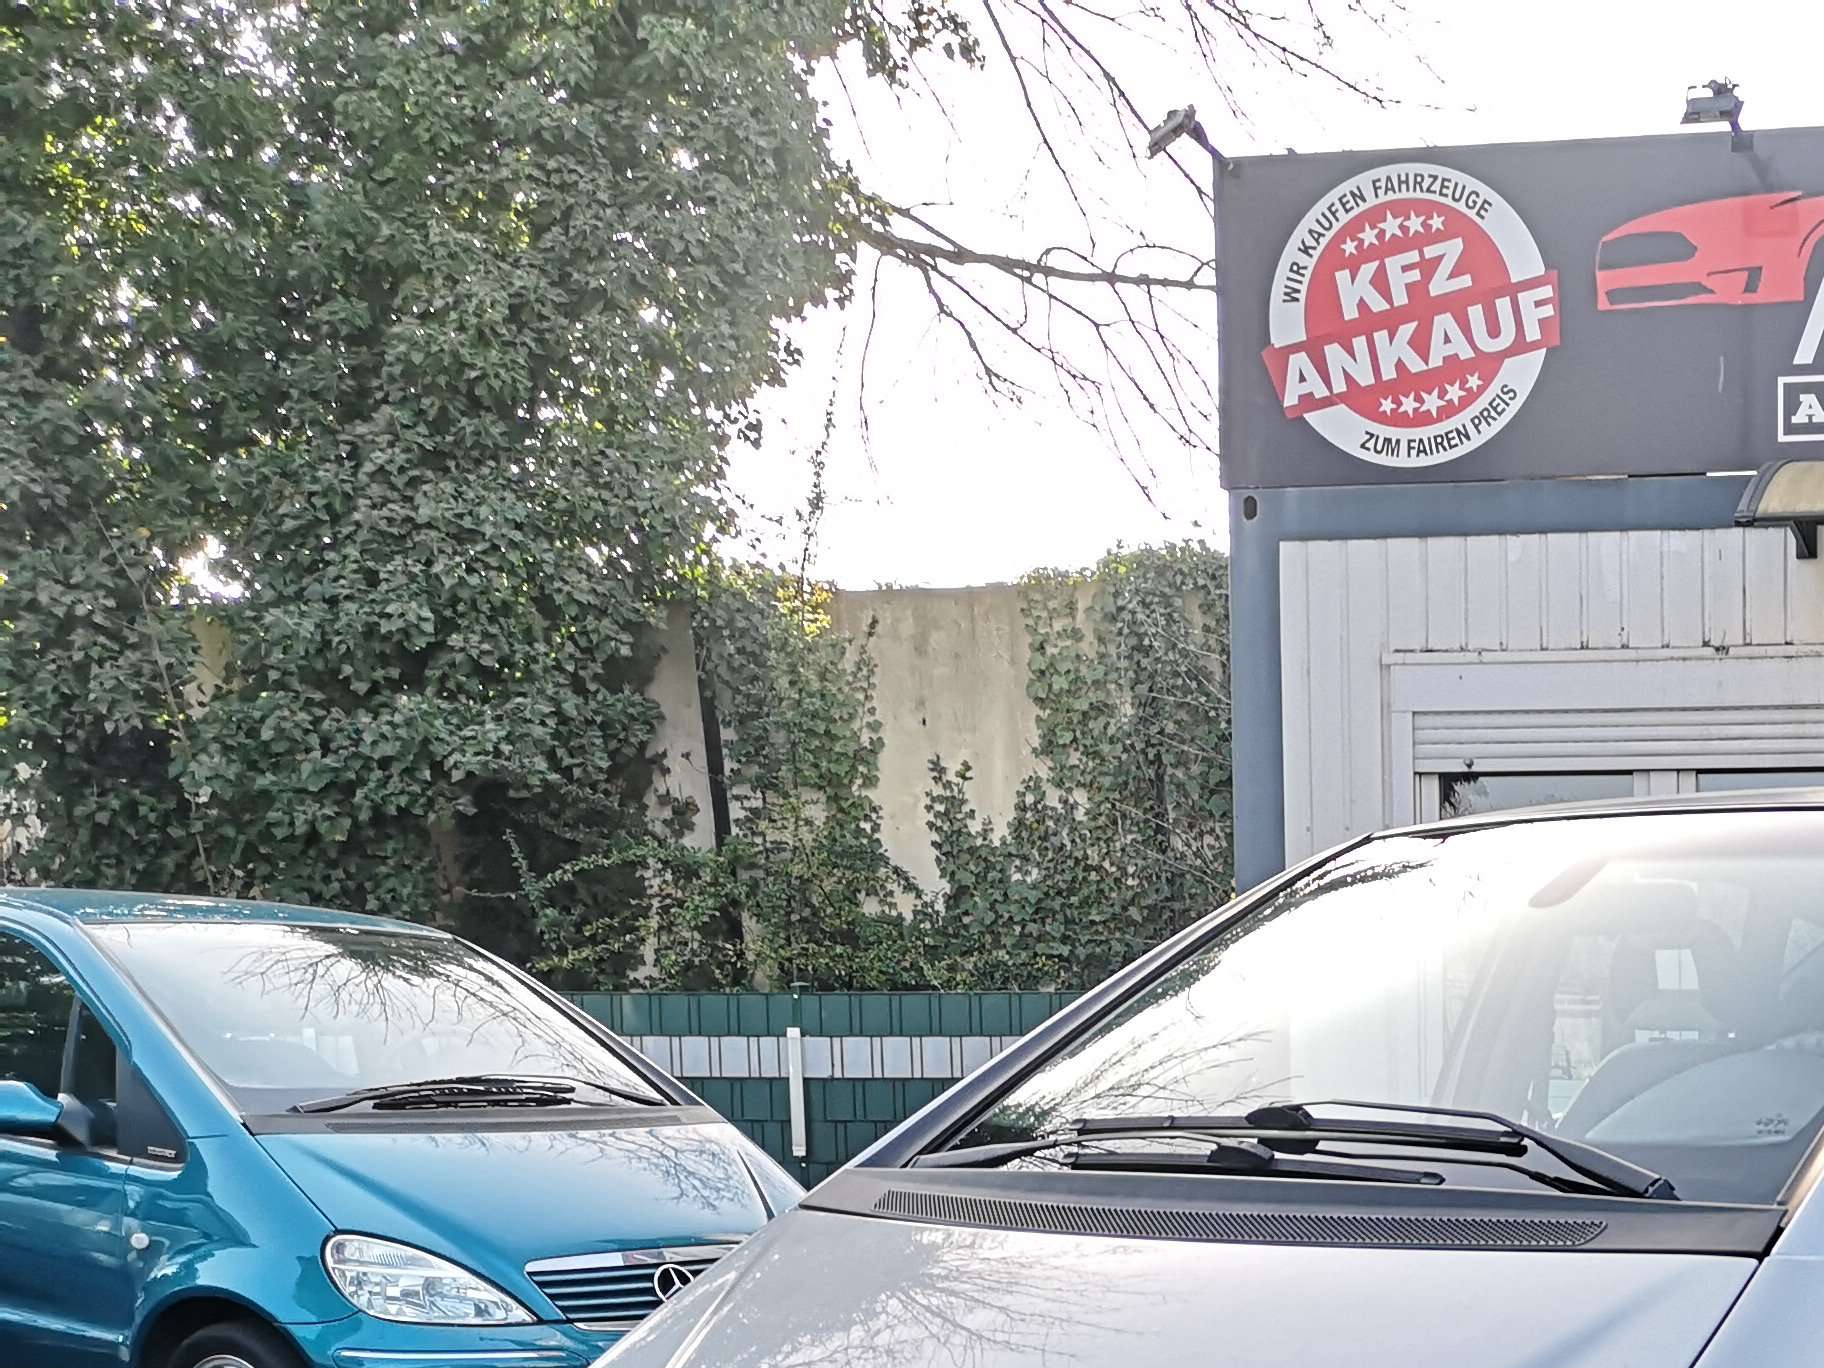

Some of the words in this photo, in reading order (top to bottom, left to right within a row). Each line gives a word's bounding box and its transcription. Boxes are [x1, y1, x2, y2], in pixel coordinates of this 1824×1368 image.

[1282, 257, 1308, 303] WIR
[1298, 185, 1368, 257] KAUFEN
[1371, 172, 1493, 221] FAHRZEUGE
[1334, 237, 1473, 321] KFZ
[1283, 284, 1555, 408] ANKAUF
[1360, 430, 1401, 458] ZUM
[1406, 427, 1471, 458] FAIREN
[1470, 383, 1518, 436] PREIS
